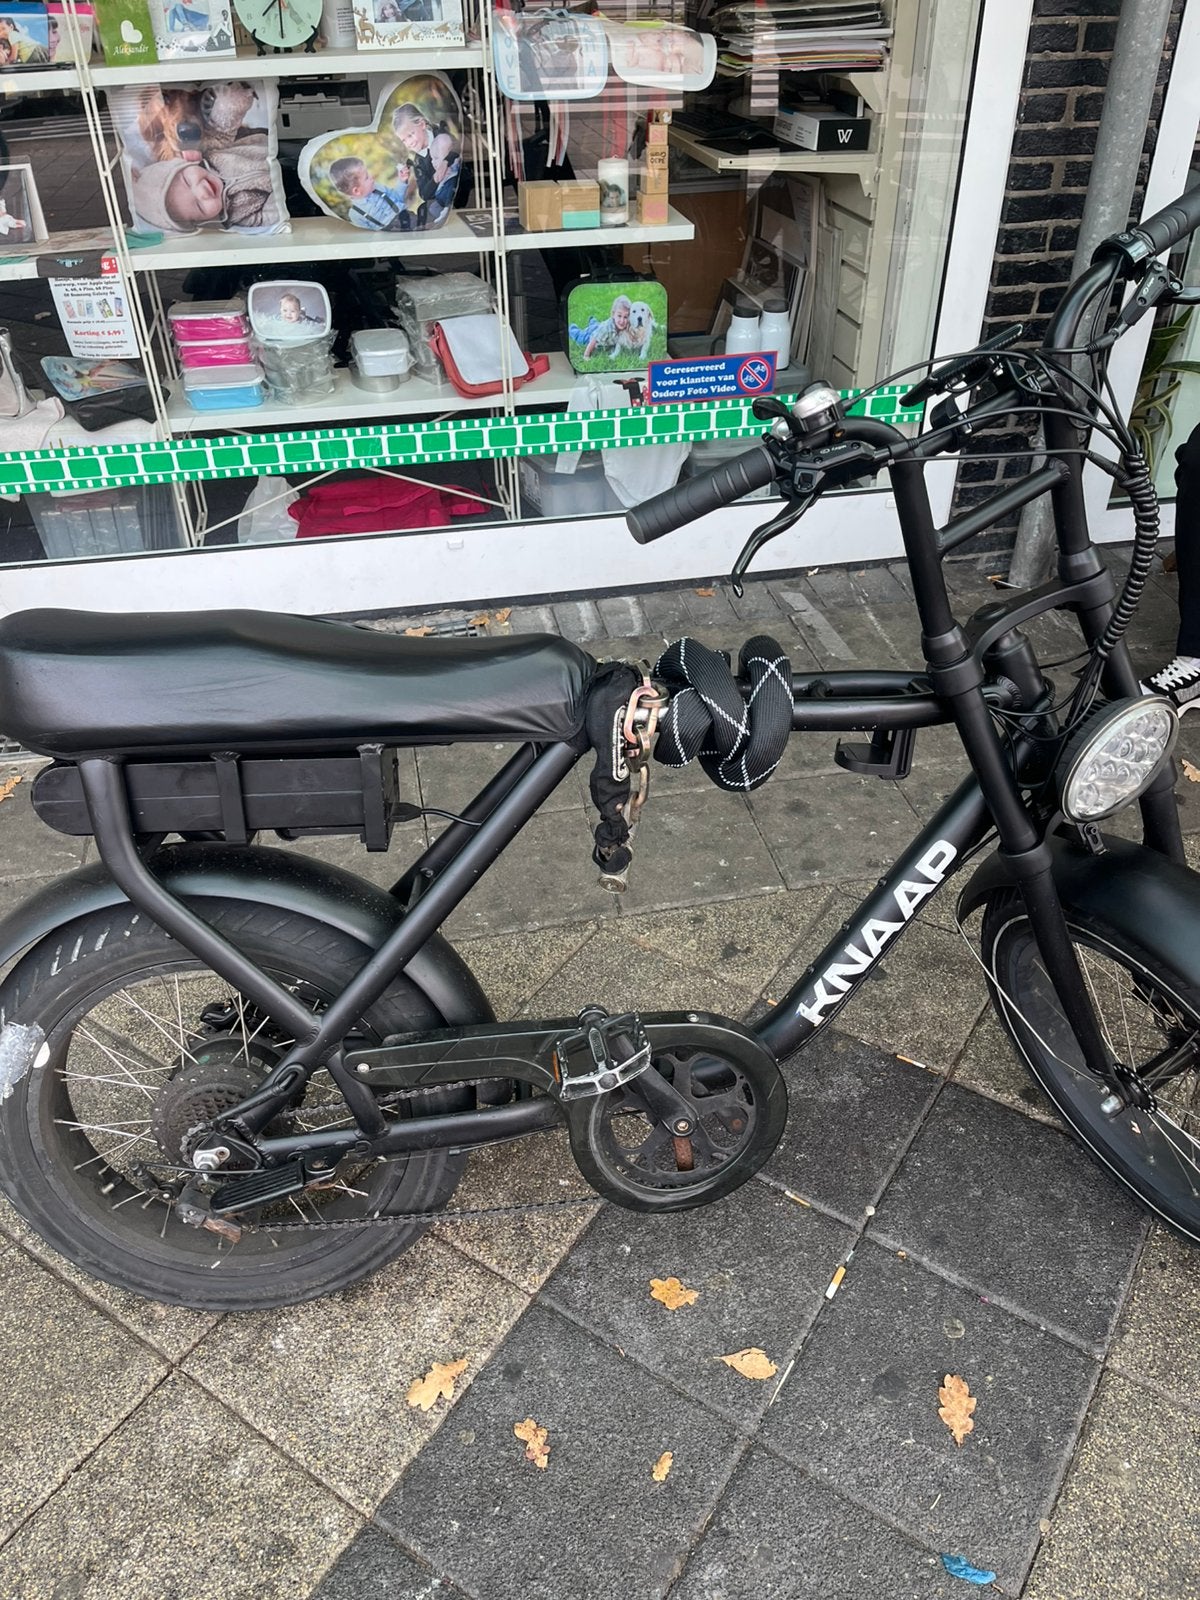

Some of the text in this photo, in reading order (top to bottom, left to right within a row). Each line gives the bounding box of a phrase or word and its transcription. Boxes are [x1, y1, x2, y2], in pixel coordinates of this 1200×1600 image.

[837, 129, 853, 143] W
[664, 362, 726, 374] Gereserveerd
[656, 373, 735, 387] voor klanten van
[651, 384, 737, 398] Osdorp Foto Video
[795, 838, 958, 1028] KNAAP
